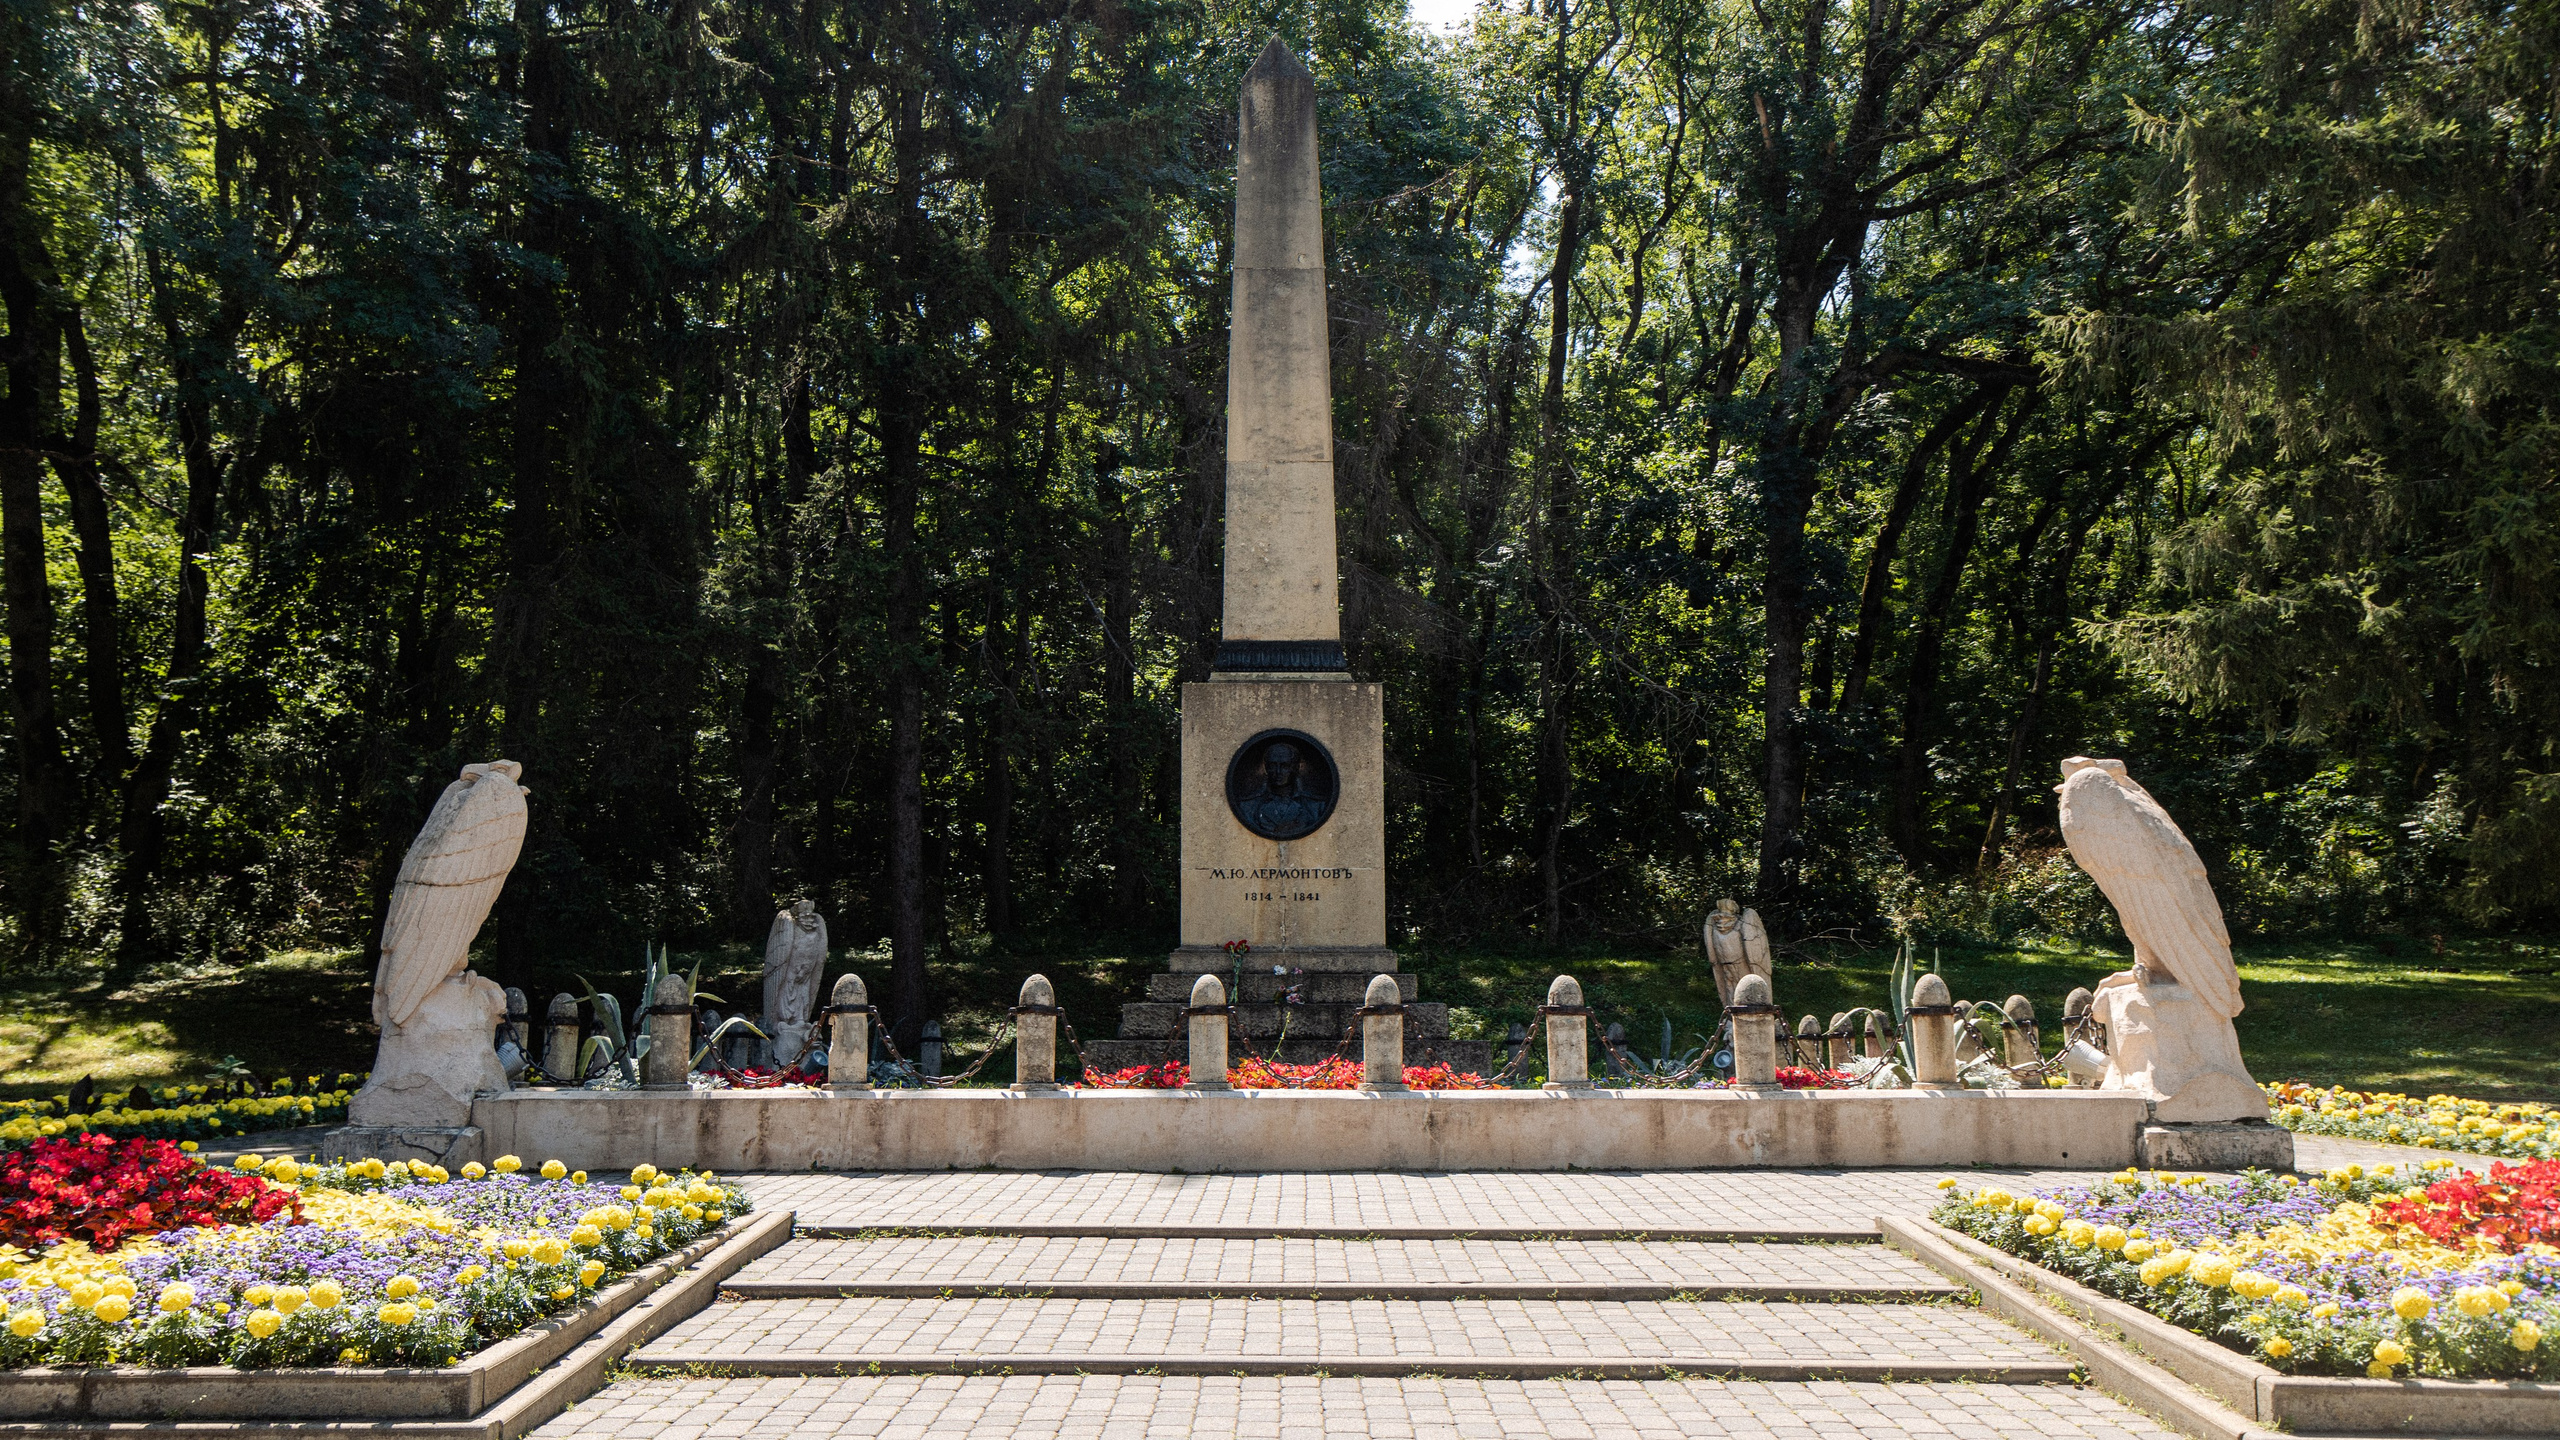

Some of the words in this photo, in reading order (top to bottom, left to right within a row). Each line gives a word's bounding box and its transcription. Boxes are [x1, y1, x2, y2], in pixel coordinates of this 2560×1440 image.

[1250, 868, 1353, 879] ЛЕРМОНТОВЪ
[1244, 892, 1273, 901] 1814
[1293, 892, 1320, 901] 1841
